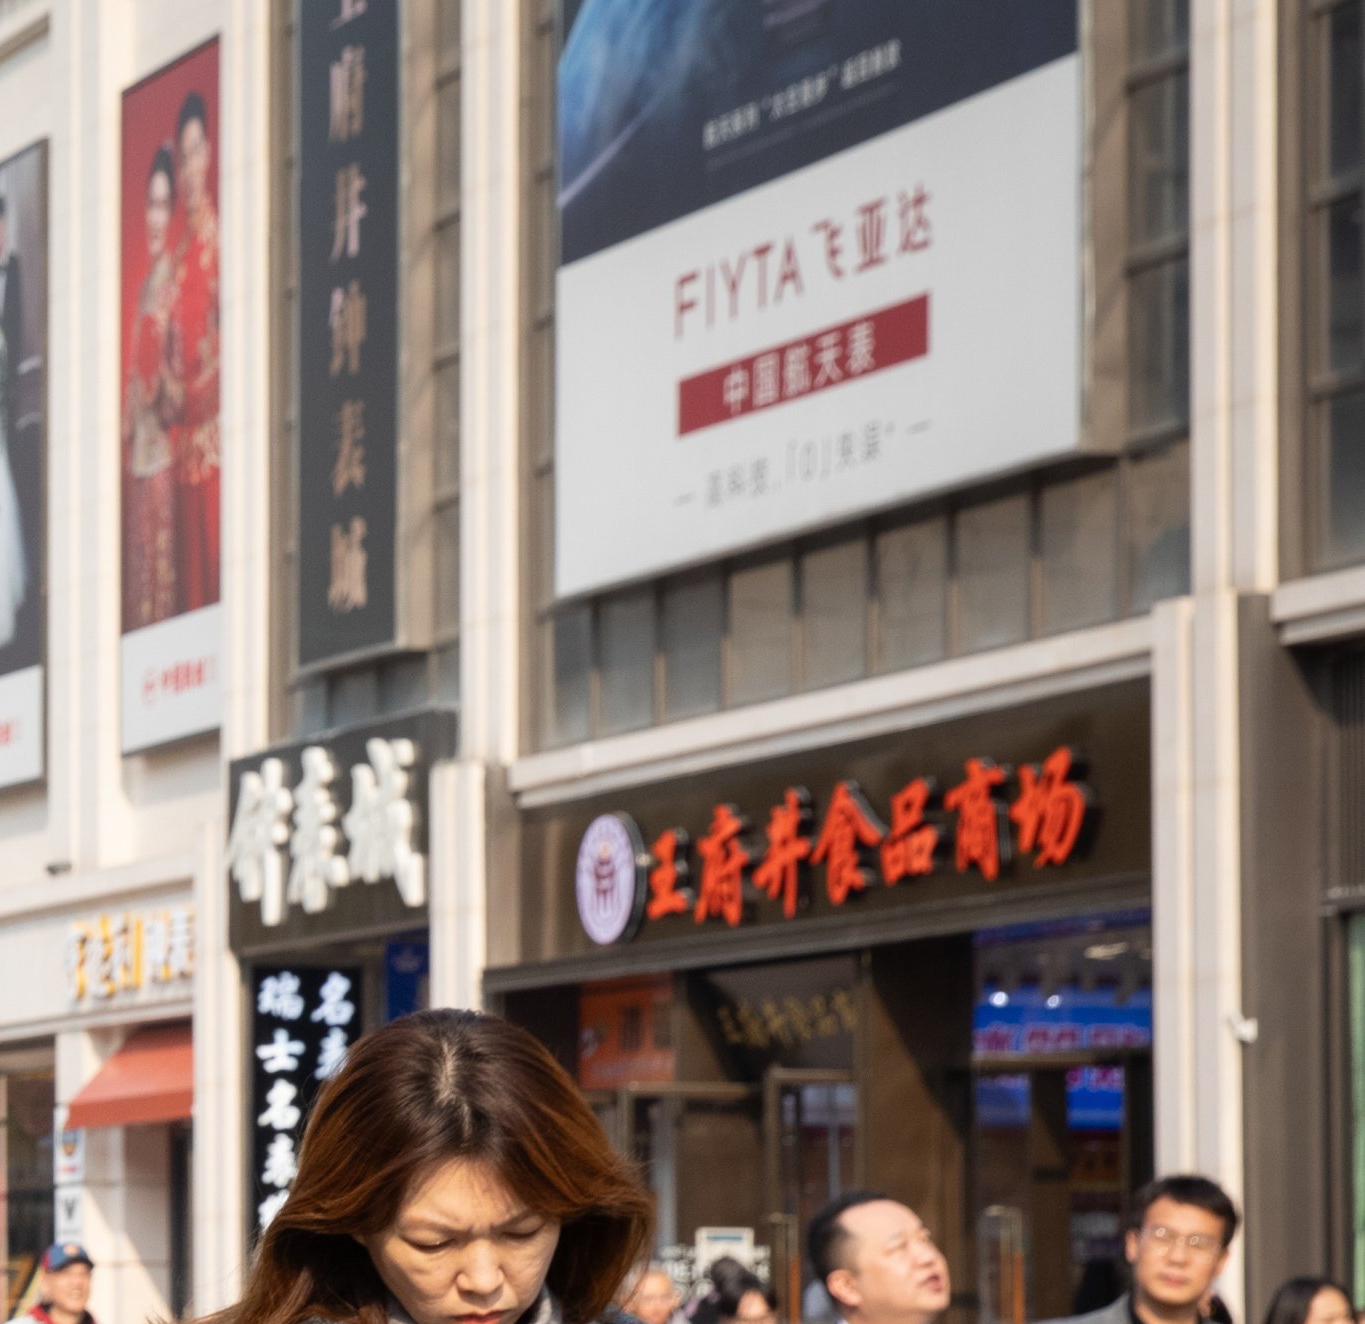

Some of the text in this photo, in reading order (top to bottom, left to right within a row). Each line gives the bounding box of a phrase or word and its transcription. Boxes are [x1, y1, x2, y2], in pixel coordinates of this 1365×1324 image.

[674, 182, 933, 338] FIYTA 飞亚达
[723, 321, 876, 415] 中国航天表
[646, 745, 1087, 927] 王府井食品商场
